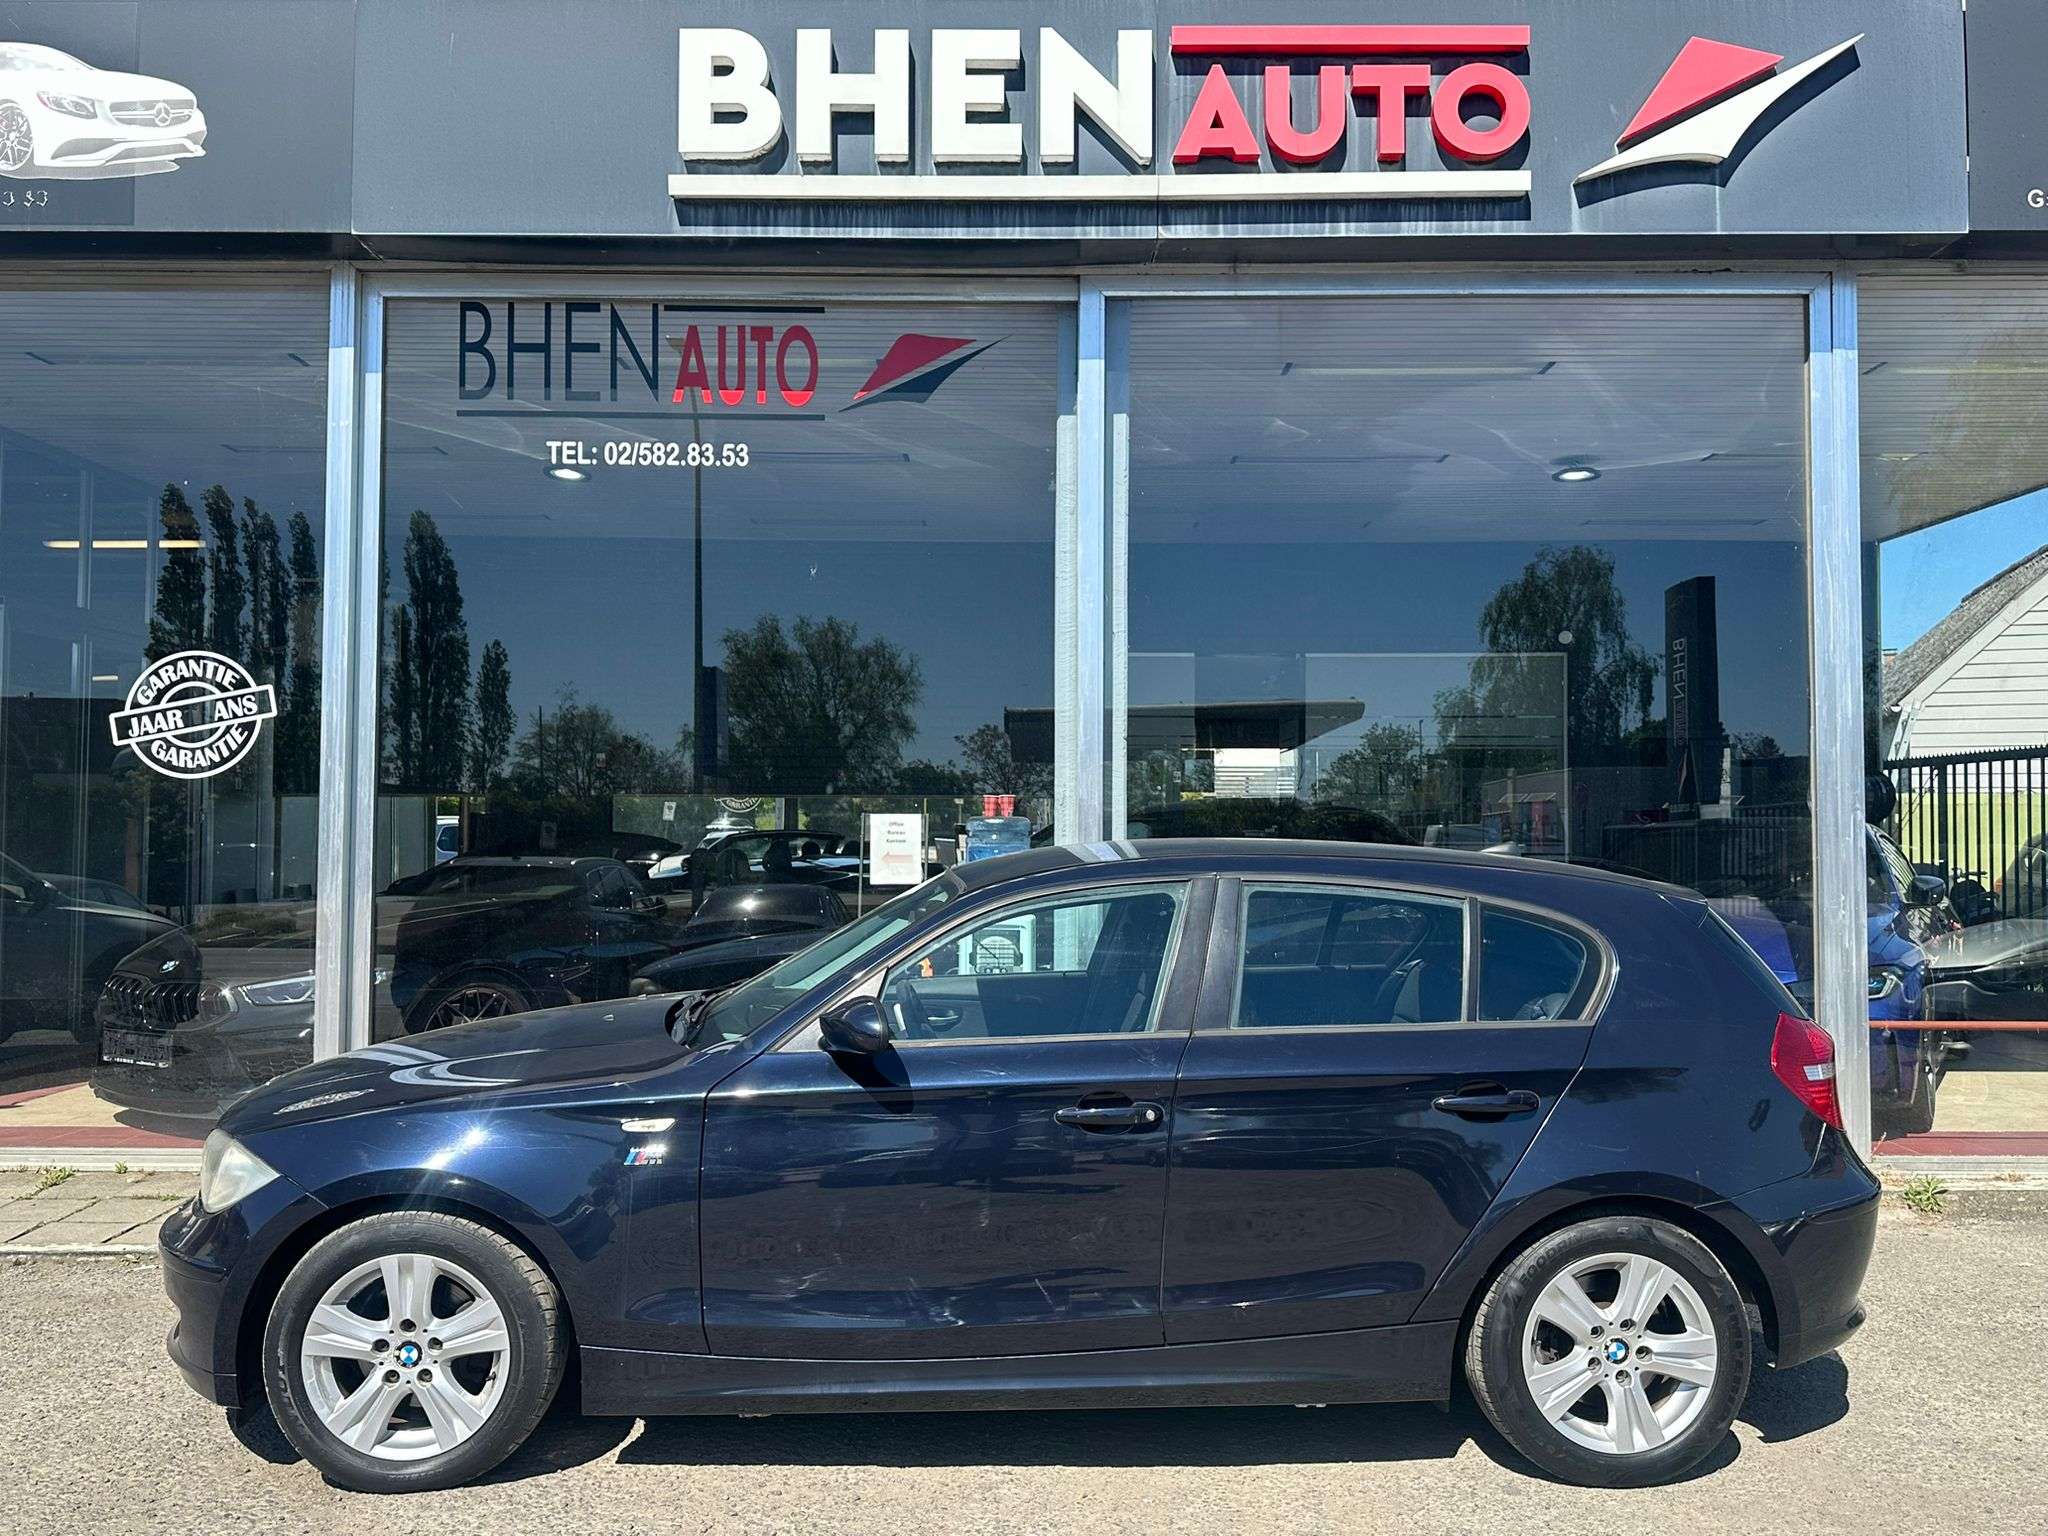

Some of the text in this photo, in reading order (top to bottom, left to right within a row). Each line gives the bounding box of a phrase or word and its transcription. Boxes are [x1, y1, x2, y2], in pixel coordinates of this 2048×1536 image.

[678, 27, 1531, 165] BHEN AUTO
[459, 301, 819, 407] BHEN AUTO
[545, 441, 749, 467] TEL: 02/582.83.53
[136, 659, 240, 706] GARANTIE
[128, 695, 258, 738] JAAR ANS
[150, 724, 249, 769] GARANTIE
